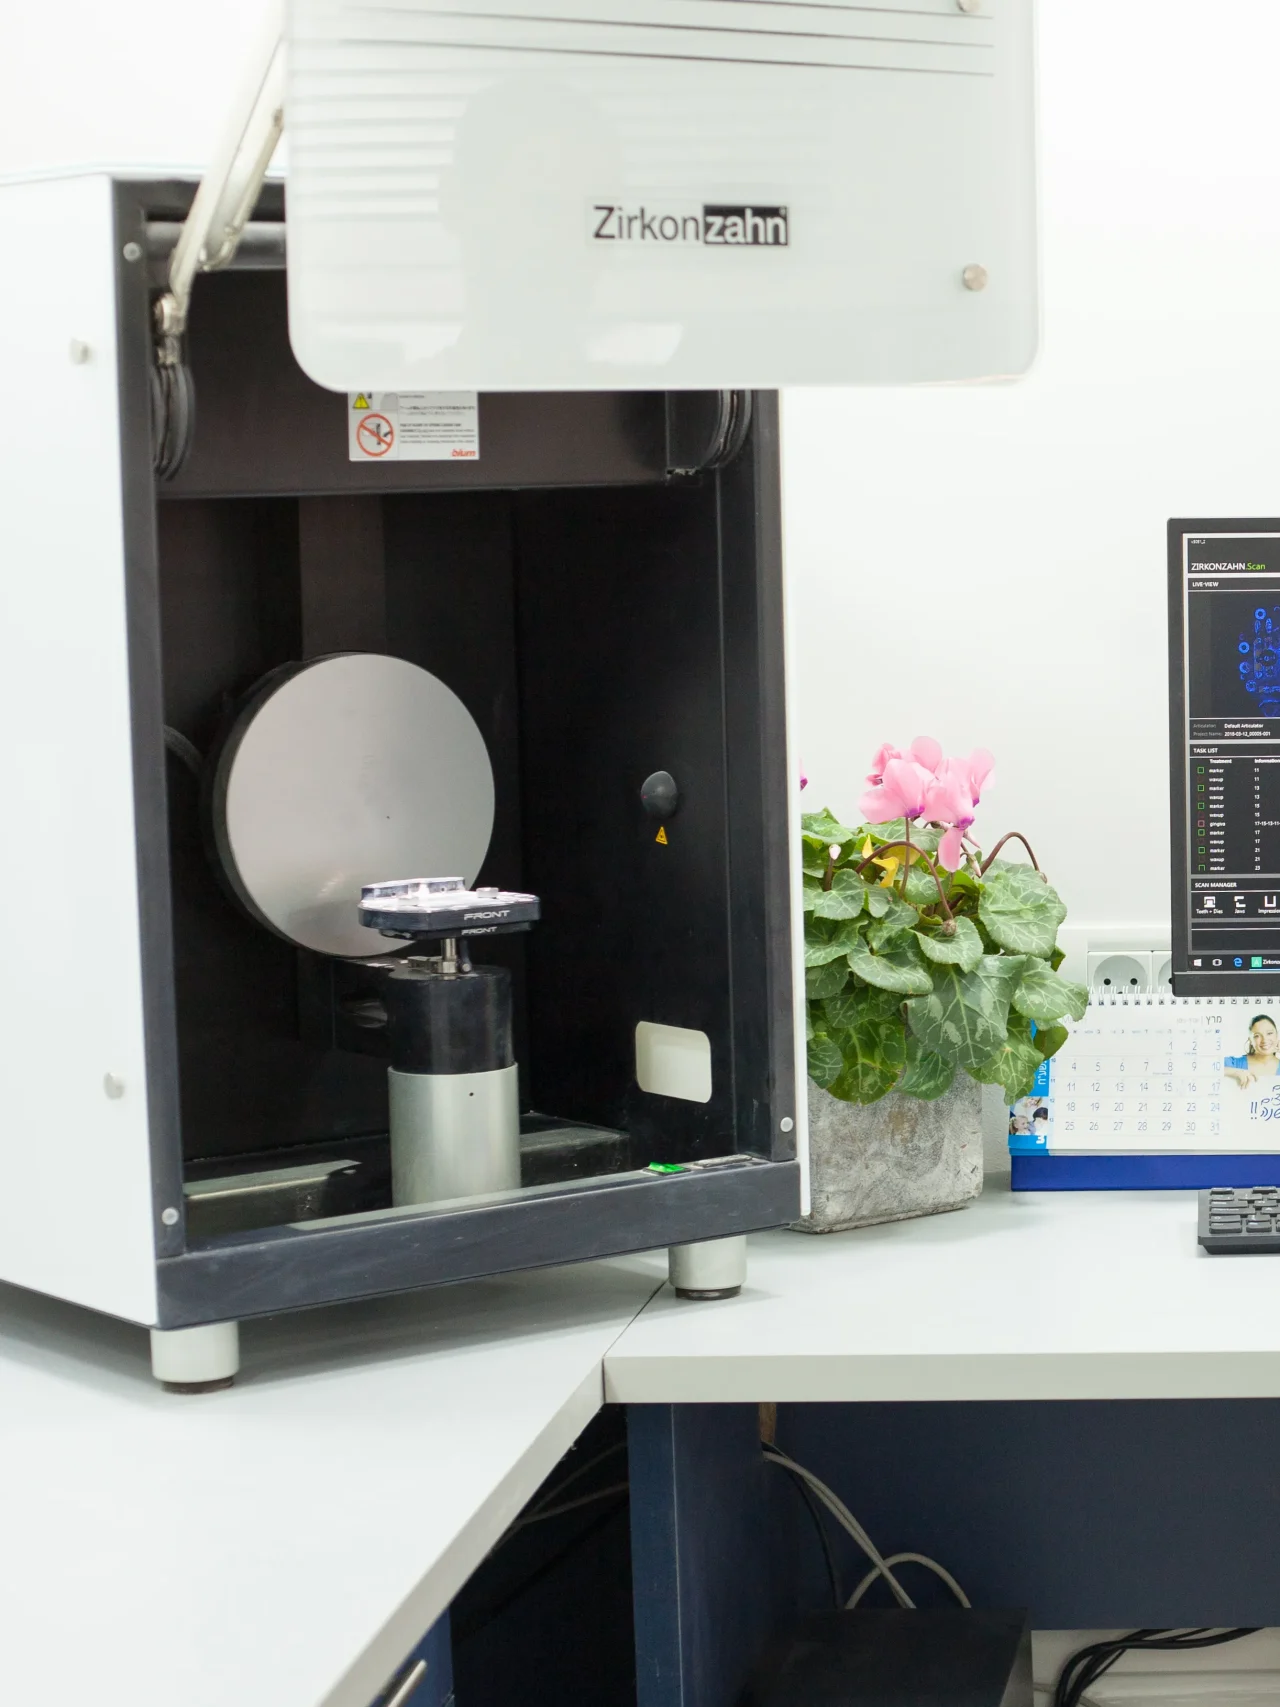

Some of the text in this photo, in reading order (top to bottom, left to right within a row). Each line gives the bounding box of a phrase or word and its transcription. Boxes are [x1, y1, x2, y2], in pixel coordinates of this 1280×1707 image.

[1191, 562, 1266, 571] ZIRKONZAHN.Scan
[464, 910, 510, 920] FRONT
[461, 926, 498, 935] FRONT
[1206, 1016, 1222, 1025] מרץ
[1192, 1041, 1197, 1050] 2
[1216, 1041, 1221, 1050] 3
[1071, 1062, 1221, 1071] 4 5 6 7 8 9 10
[1067, 1082, 1220, 1092] 11 12 13 14 15 16 17
[1066, 1102, 1220, 1112] 18 19 20 21 22 23 24
[1065, 1122, 1220, 1131] 25 26 27 28 29 30 31
